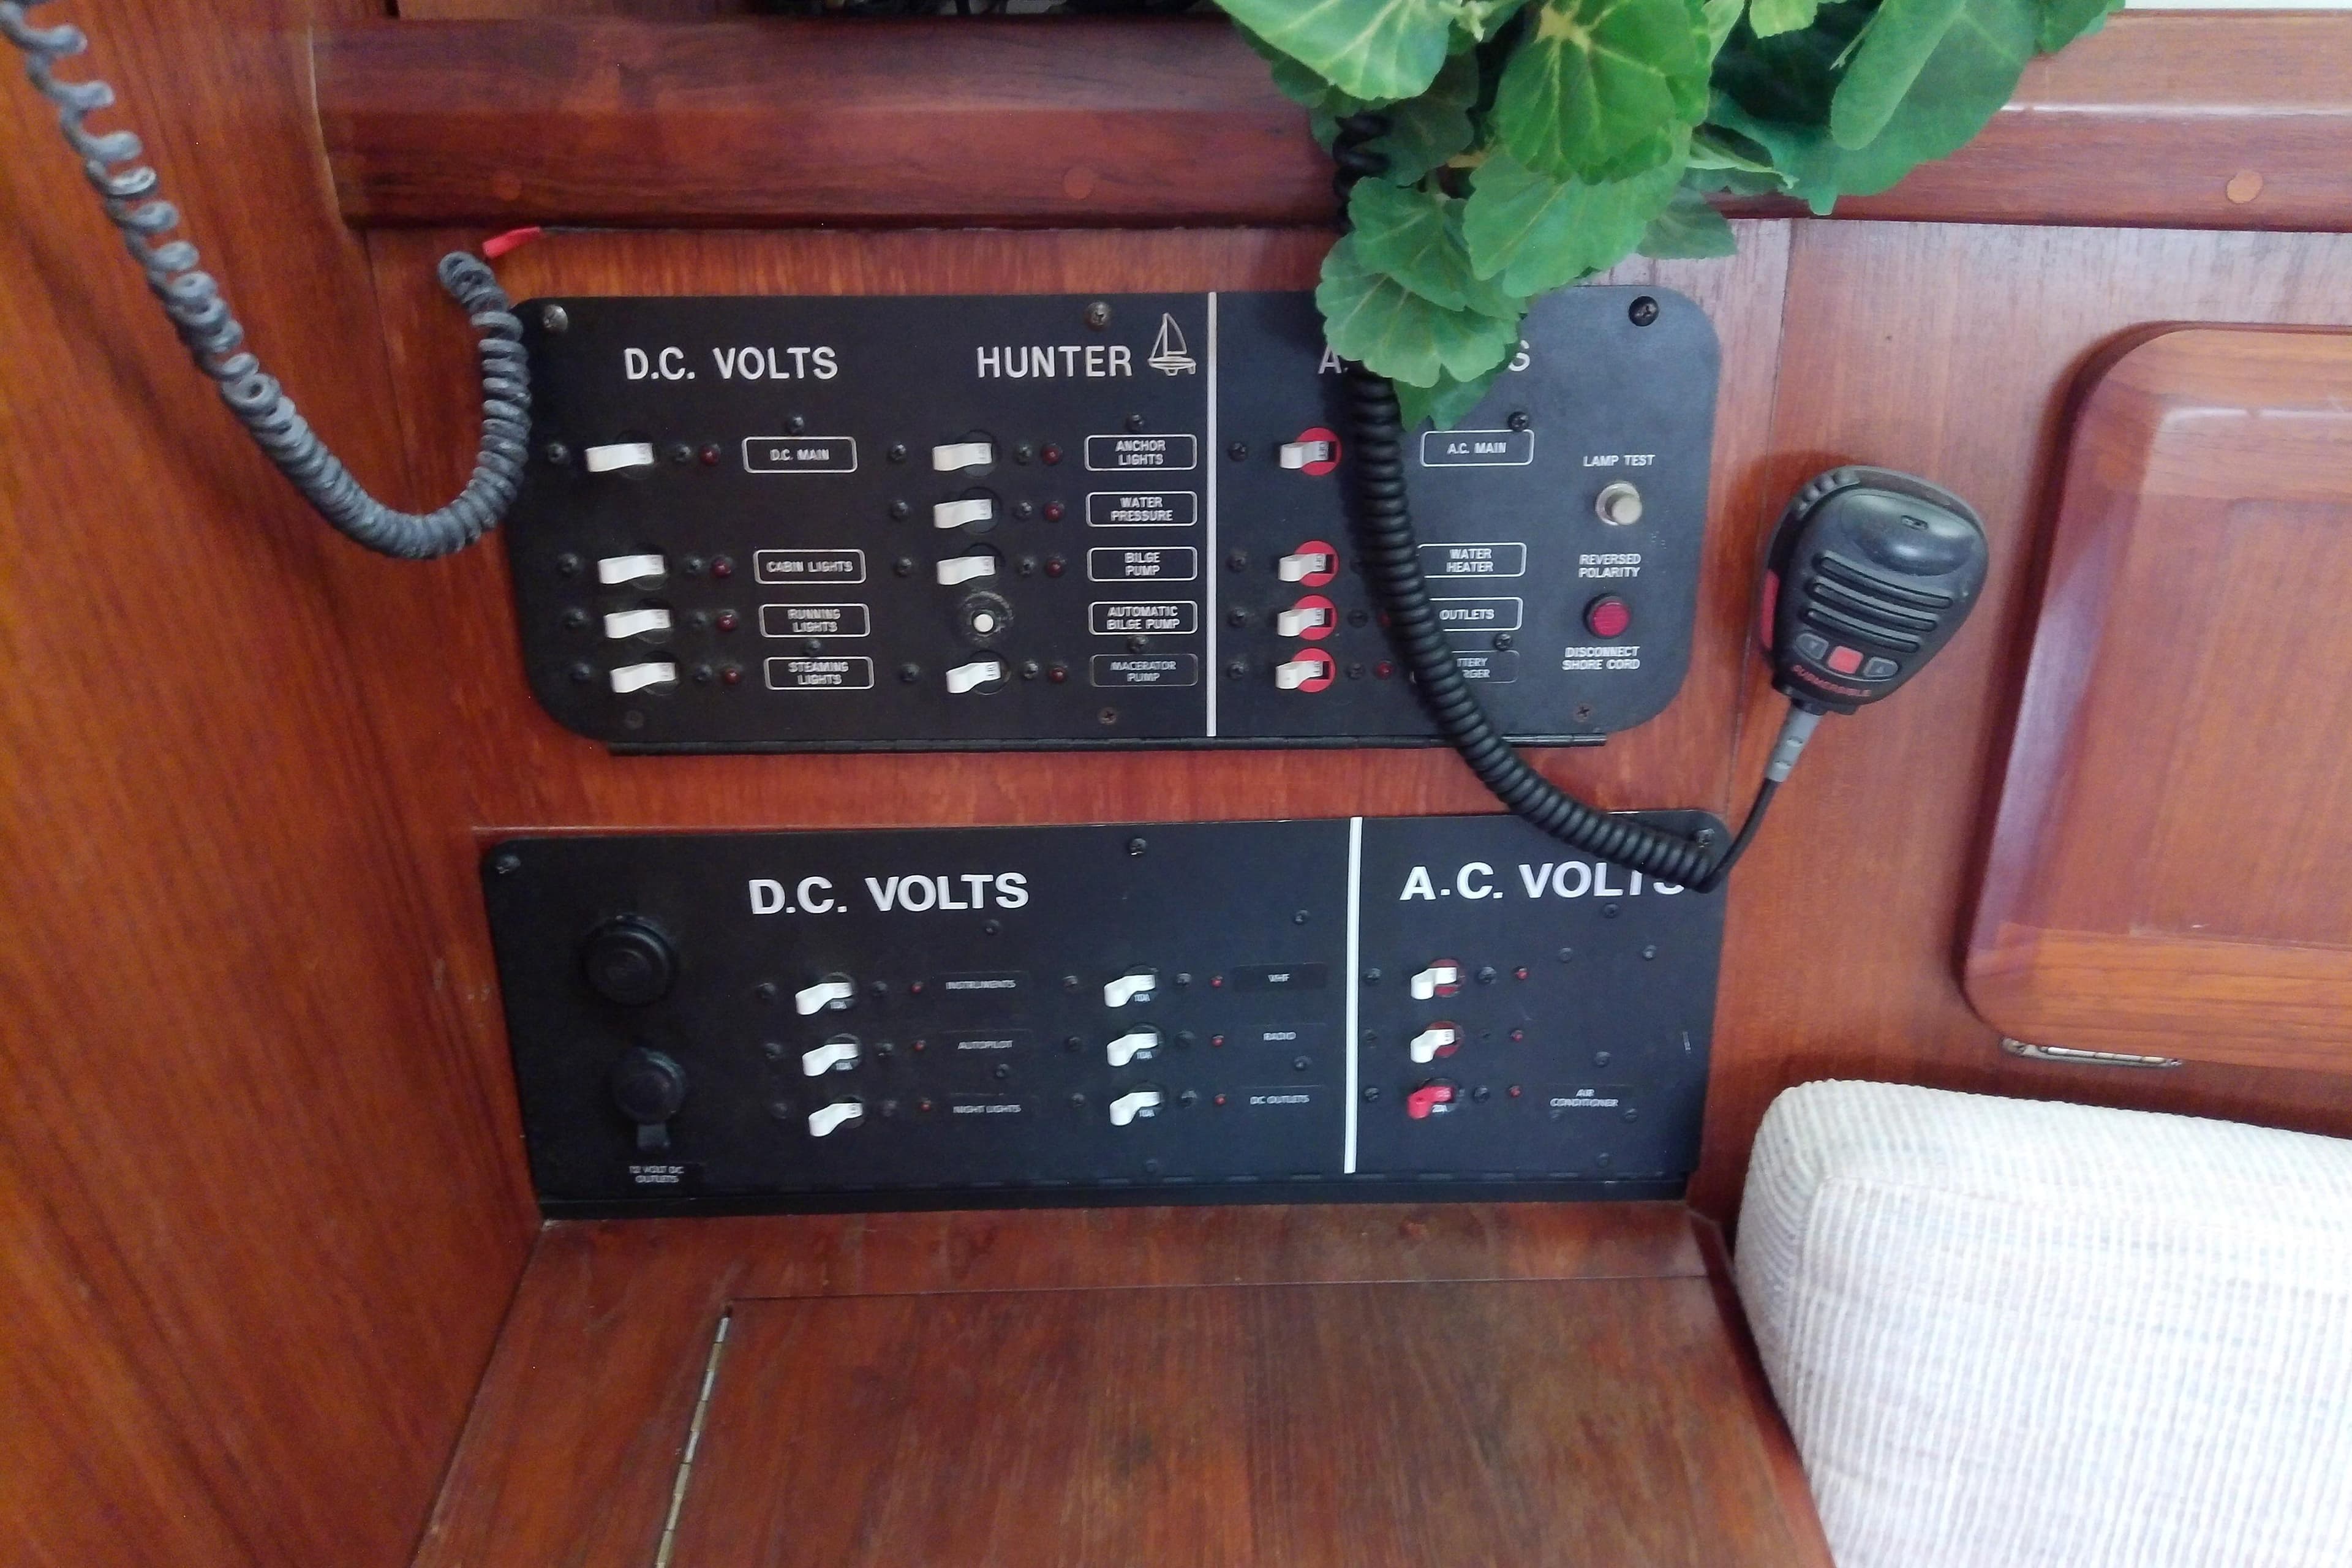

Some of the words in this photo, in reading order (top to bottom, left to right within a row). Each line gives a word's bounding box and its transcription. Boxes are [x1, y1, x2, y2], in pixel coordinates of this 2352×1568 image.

[624, 346, 695, 380] D.C.
[712, 346, 838, 380] VOLTS
[976, 345, 1133, 378] HUNTER
[1115, 440, 1166, 451] ANCHOR
[1447, 442, 1470, 454] A.C.
[1474, 442, 1507, 454] MAIN
[796, 448, 830, 461] MAIN
[1118, 453, 1164, 466] LIGHTS
[1583, 454, 1619, 467] LAMP
[1623, 454, 1656, 466] TEST
[1120, 496, 1163, 508] WATER
[1110, 510, 1174, 521] PRESSURE
[1125, 552, 1161, 564] BILGE
[1449, 548, 1492, 559] WATER
[1579, 553, 1642, 565] REVERSED
[766, 561, 804, 573] CABIN
[807, 560, 853, 573] LIGHTS
[1125, 565, 1160, 576] PUMP
[1446, 561, 1493, 573] HEATER
[1578, 567, 1640, 578] POLARITY
[788, 609, 841, 619] RUNNING
[1108, 606, 1178, 617] AUTOMATIC
[1439, 609, 1494, 620] OUTLETS
[793, 621, 838, 633] LIGHTS
[1107, 619, 1142, 630] BILGE
[1145, 618, 1180, 629] PUMP
[1564, 646, 1640, 658] DISCONNECT
[789, 662, 849, 673] STEAMING
[1110, 661, 1177, 671] MACERATOR
[1457, 657, 1488, 667] TTERY
[1562, 659, 1603, 670] SHORE
[1606, 658, 1640, 669] CORD
[797, 674, 842, 685] LIGHTS
[1126, 673, 1160, 682] PUMP
[1399, 862, 1503, 900] A.C.
[748, 876, 847, 914] D.C.
[864, 872, 1029, 912] VOLTS
[1268, 973, 1290, 982] VHF
[945, 979, 1016, 990] INSTRUMENTS
[1263, 1031, 1297, 1041] RADIO
[957, 1040, 1013, 1050] AUTOPILOT
[1575, 1088, 1595, 1097] AIR
[1250, 1096, 1266, 1105] DC
[1267, 1095, 1310, 1104] OUTLETS
[1550, 1098, 1618, 1107] CONDITIONER
[953, 1105, 986, 1114] NIGHT
[986, 1104, 1022, 1114] LIGHTS
